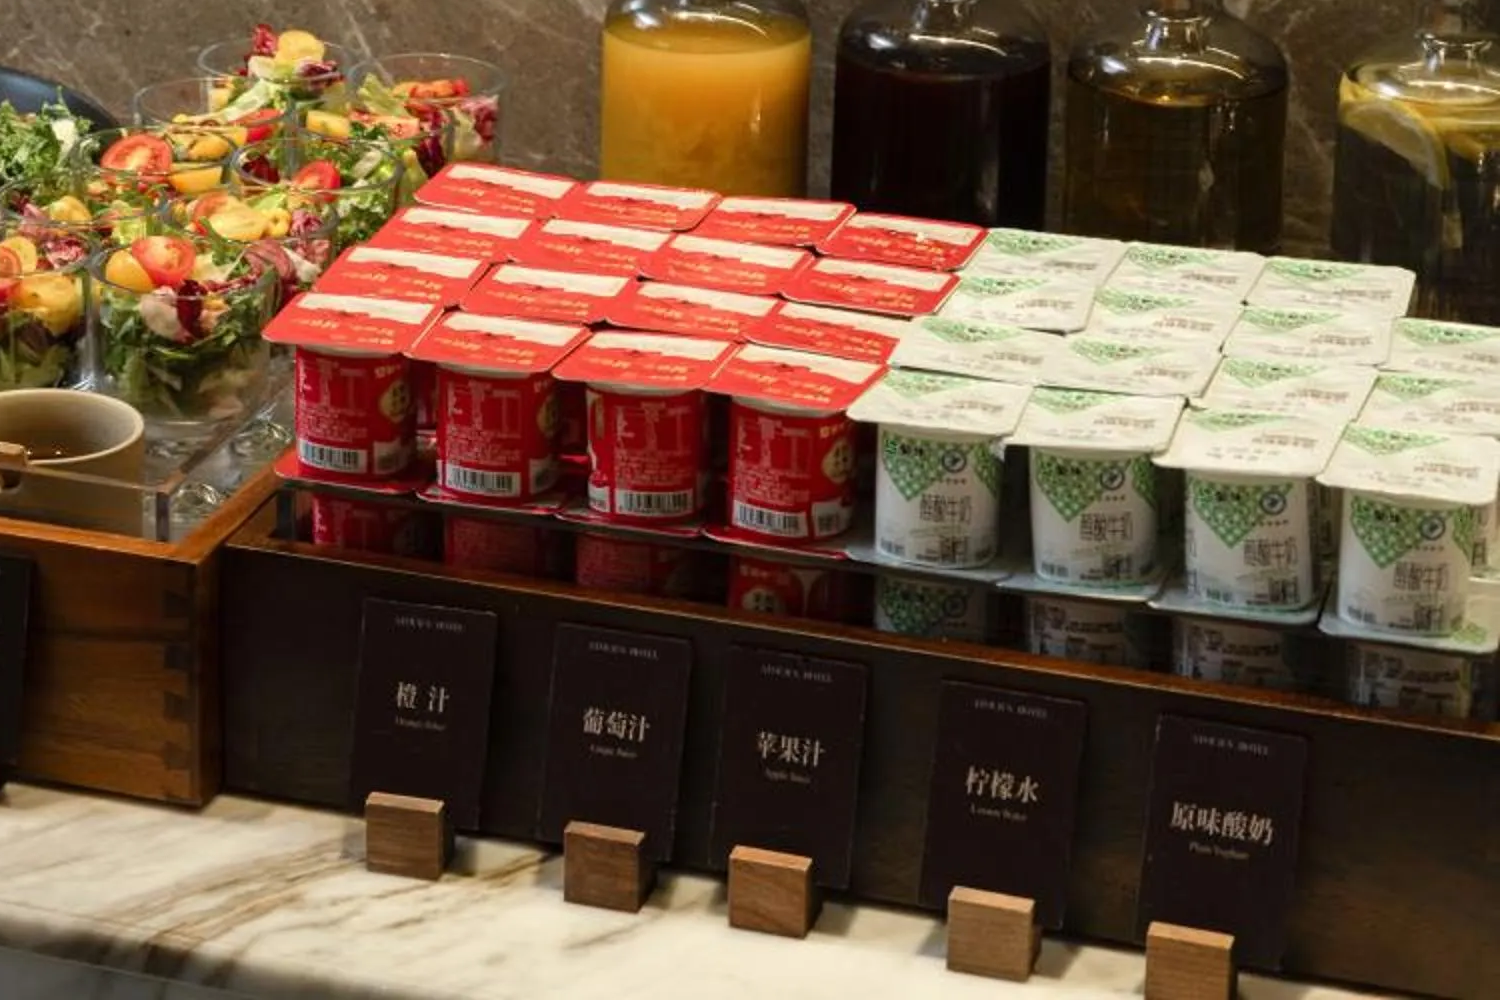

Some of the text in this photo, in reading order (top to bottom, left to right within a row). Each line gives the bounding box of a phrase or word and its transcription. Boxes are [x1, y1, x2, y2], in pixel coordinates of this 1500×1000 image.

[396, 682, 450, 713] 橙汁
[583, 706, 650, 742] 葡萄汁
[757, 731, 826, 767] 苹果汁
[966, 766, 1039, 803] 柠檬水
[1171, 801, 1274, 846] 原味酸奶
